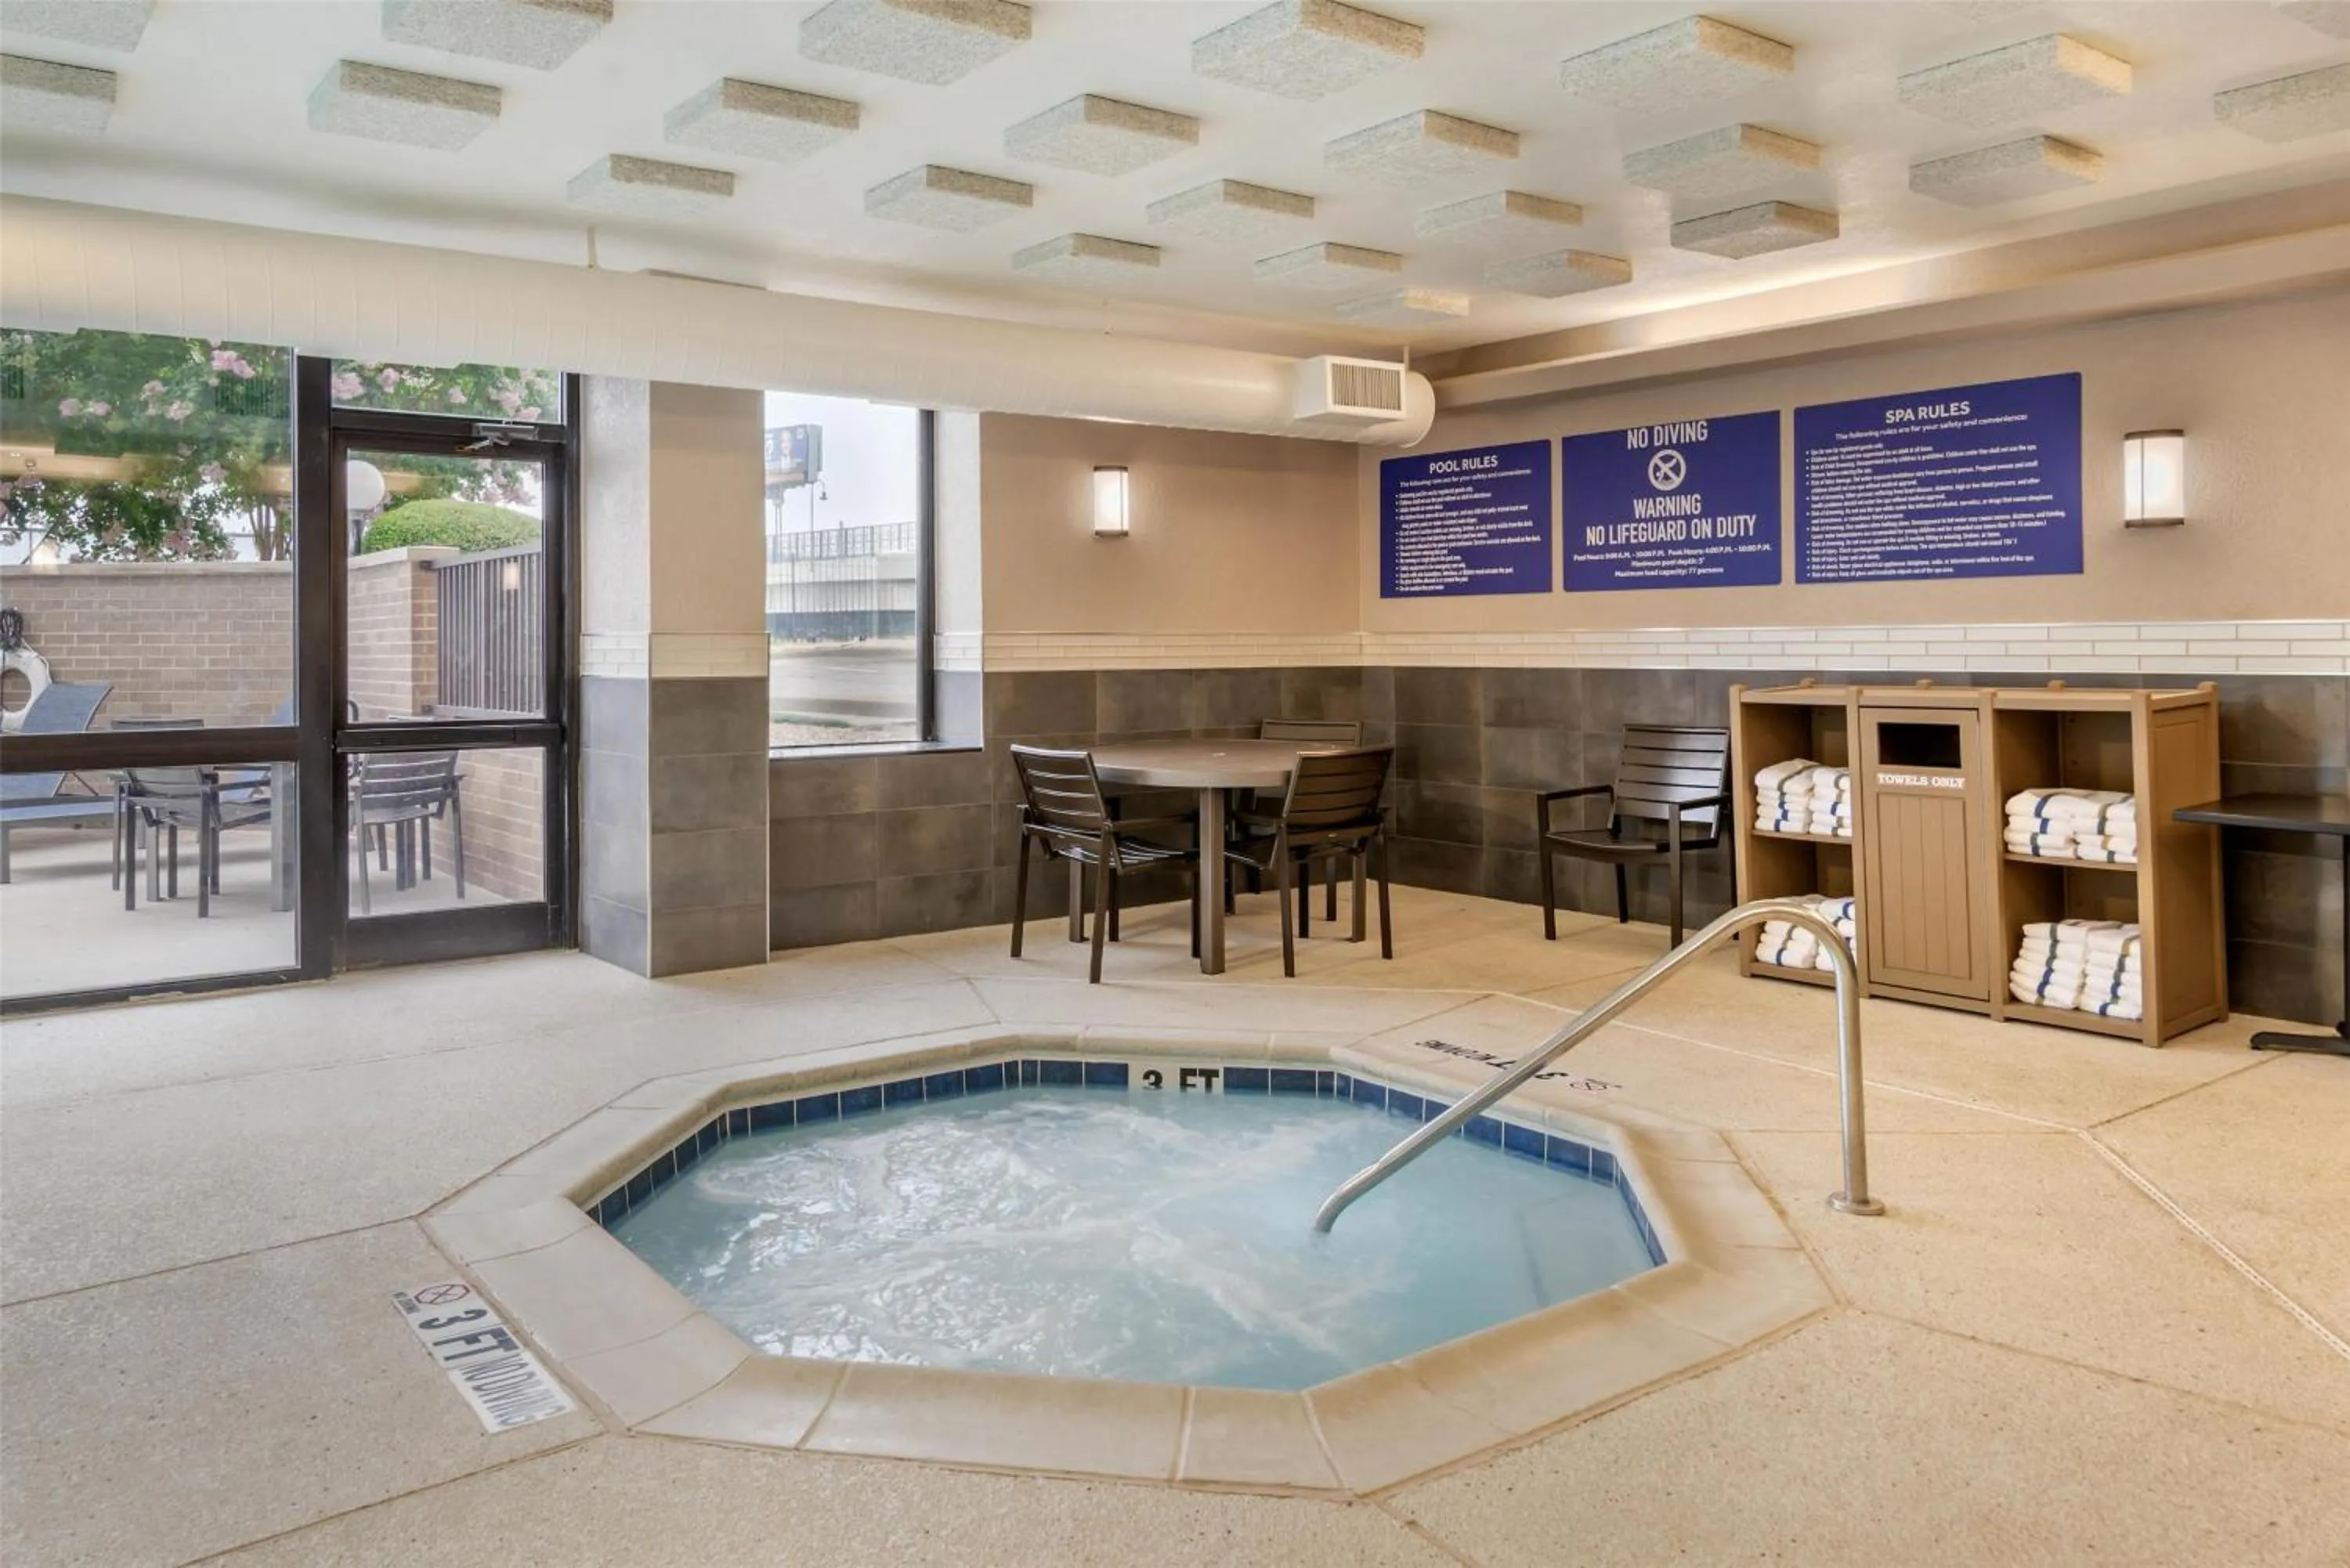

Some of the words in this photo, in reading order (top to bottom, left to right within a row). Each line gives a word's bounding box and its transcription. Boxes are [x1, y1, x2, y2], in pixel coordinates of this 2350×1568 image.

[1885, 409, 1915, 424] SPA
[1918, 400, 1971, 420] RULES
[1627, 428, 1648, 450] NO
[1654, 421, 1708, 446] DIVING
[1922, 424, 1940, 432] your
[1940, 420, 1962, 429] safety
[1963, 418, 1978, 427] and
[1429, 461, 1460, 475] POOL
[1462, 454, 1499, 471] RULES
[1633, 493, 1701, 519] WARNING
[1586, 526, 1605, 546] NO
[1609, 518, 1686, 544] LIFEGUARD
[1690, 518, 1712, 540] ON
[1716, 515, 1757, 537] DUTY
[1756, 543, 1771, 551] P.M.
[1877, 774, 1928, 786] TOWELS
[1930, 776, 1965, 789] ONLY
[1142, 1068, 1163, 1090] 3
[1180, 1068, 1220, 1093] FT
[418, 1309, 488, 1329] 3
[432, 1326, 520, 1362] FT
[458, 1353, 530, 1382] NO
